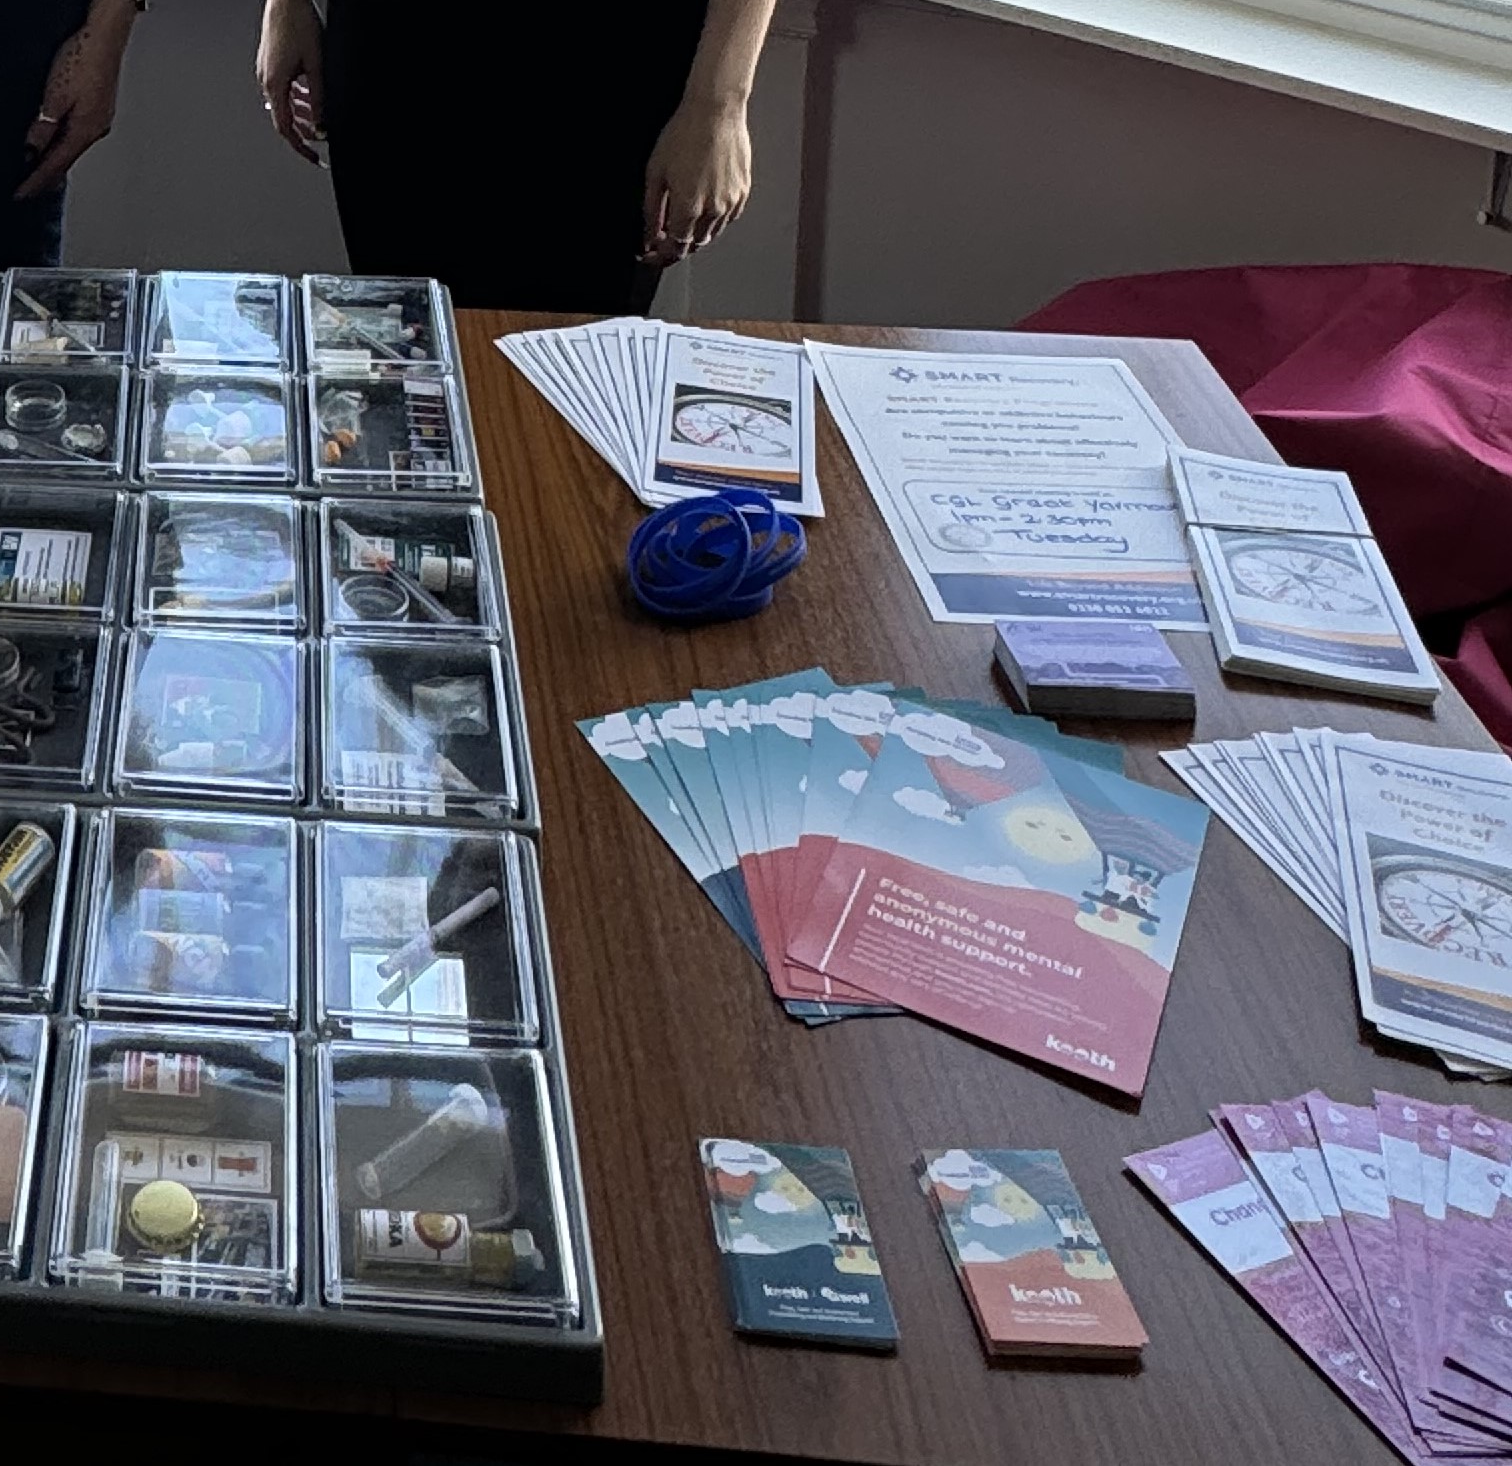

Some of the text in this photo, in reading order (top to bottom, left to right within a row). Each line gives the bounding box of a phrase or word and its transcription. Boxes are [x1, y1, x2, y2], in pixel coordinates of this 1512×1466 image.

[924, 370, 1002, 383] SMART
[930, 493, 1178, 512] CGL Great Yarmou
[992, 528, 1130, 553] Tuesday
[1380, 789, 1508, 828] Discover the
[1400, 808, 1495, 843] Power of
[1413, 827, 1485, 852] Choice
[879, 877, 1026, 942] Free, safe and
[867, 904, 1032, 978] health support.
[873, 892, 998, 947] anonymous
[1002, 941, 1083, 979] mental
